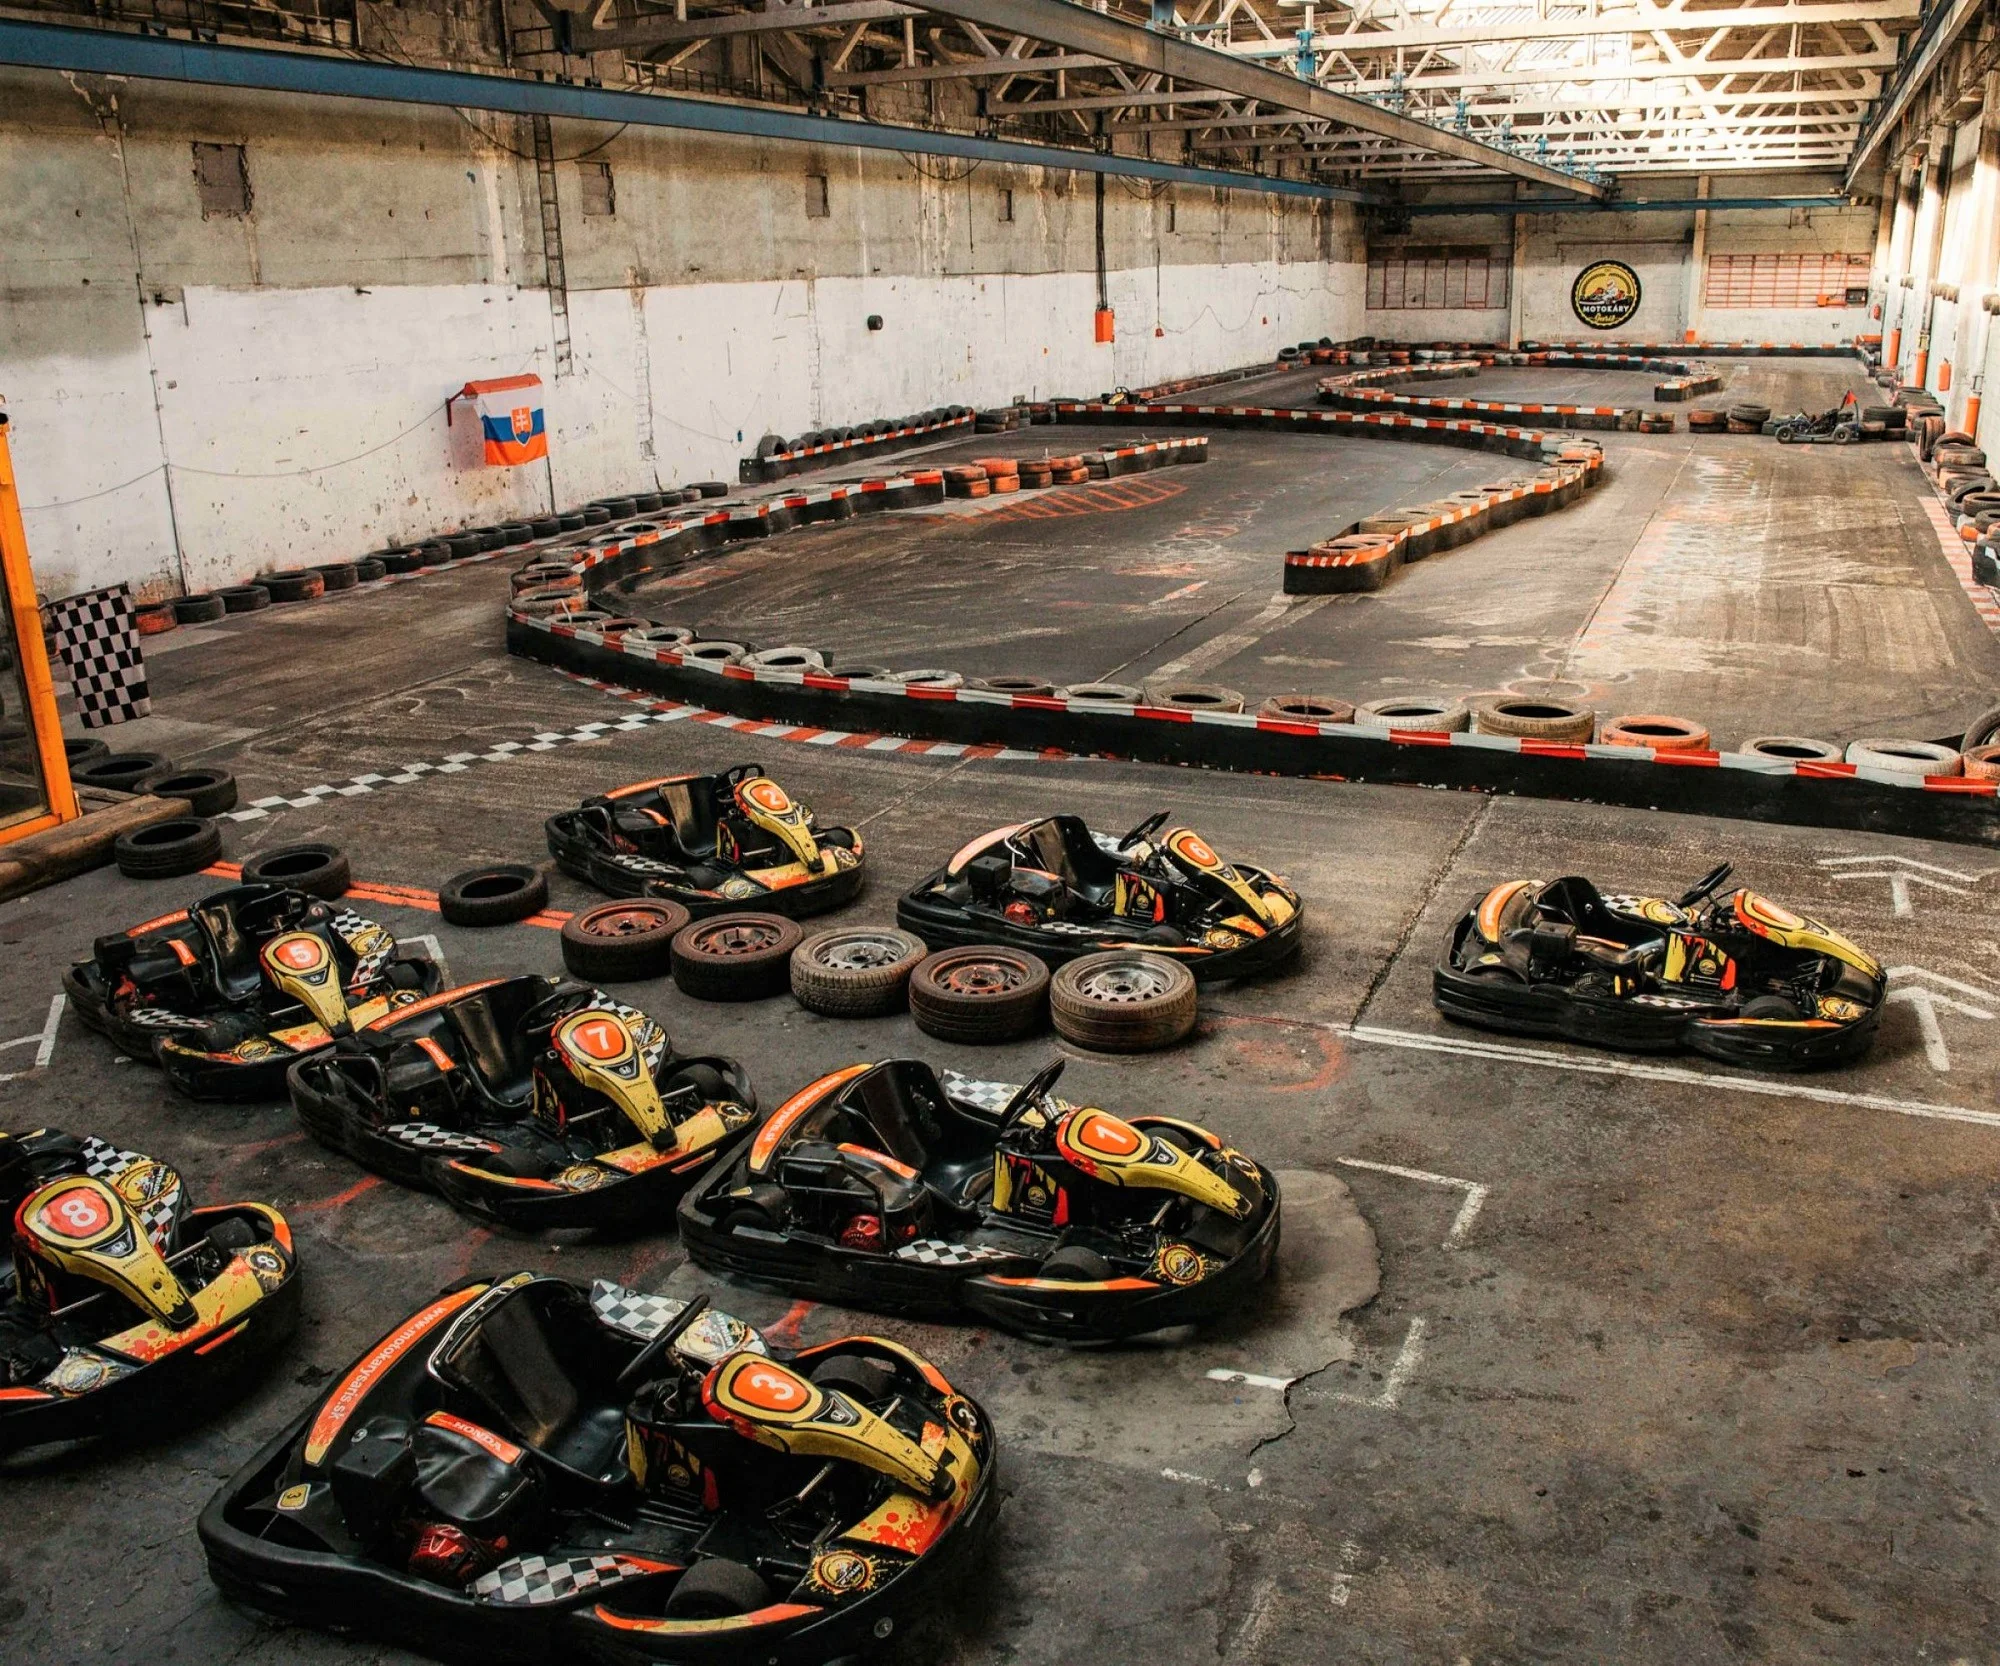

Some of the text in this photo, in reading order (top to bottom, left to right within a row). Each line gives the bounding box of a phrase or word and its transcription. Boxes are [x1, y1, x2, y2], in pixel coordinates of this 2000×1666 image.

[762, 789, 782, 805] 2
[1190, 844, 1208, 859] 6
[291, 945, 313, 963] 5
[402, 994, 415, 1003] 5
[586, 1026, 610, 1050] 7
[726, 1105, 743, 1116] 7
[1095, 1124, 1128, 1145] 1
[1235, 1158, 1252, 1169] 1
[61, 1199, 97, 1227] 8
[256, 1255, 277, 1269] 8
[326, 1305, 447, 1420] www.motokarysaris.sk
[751, 1373, 795, 1402] 3
[859, 1417, 877, 1438] HONDA
[958, 1408, 977, 1428] 3
[454, 1420, 502, 1452] HONDA
